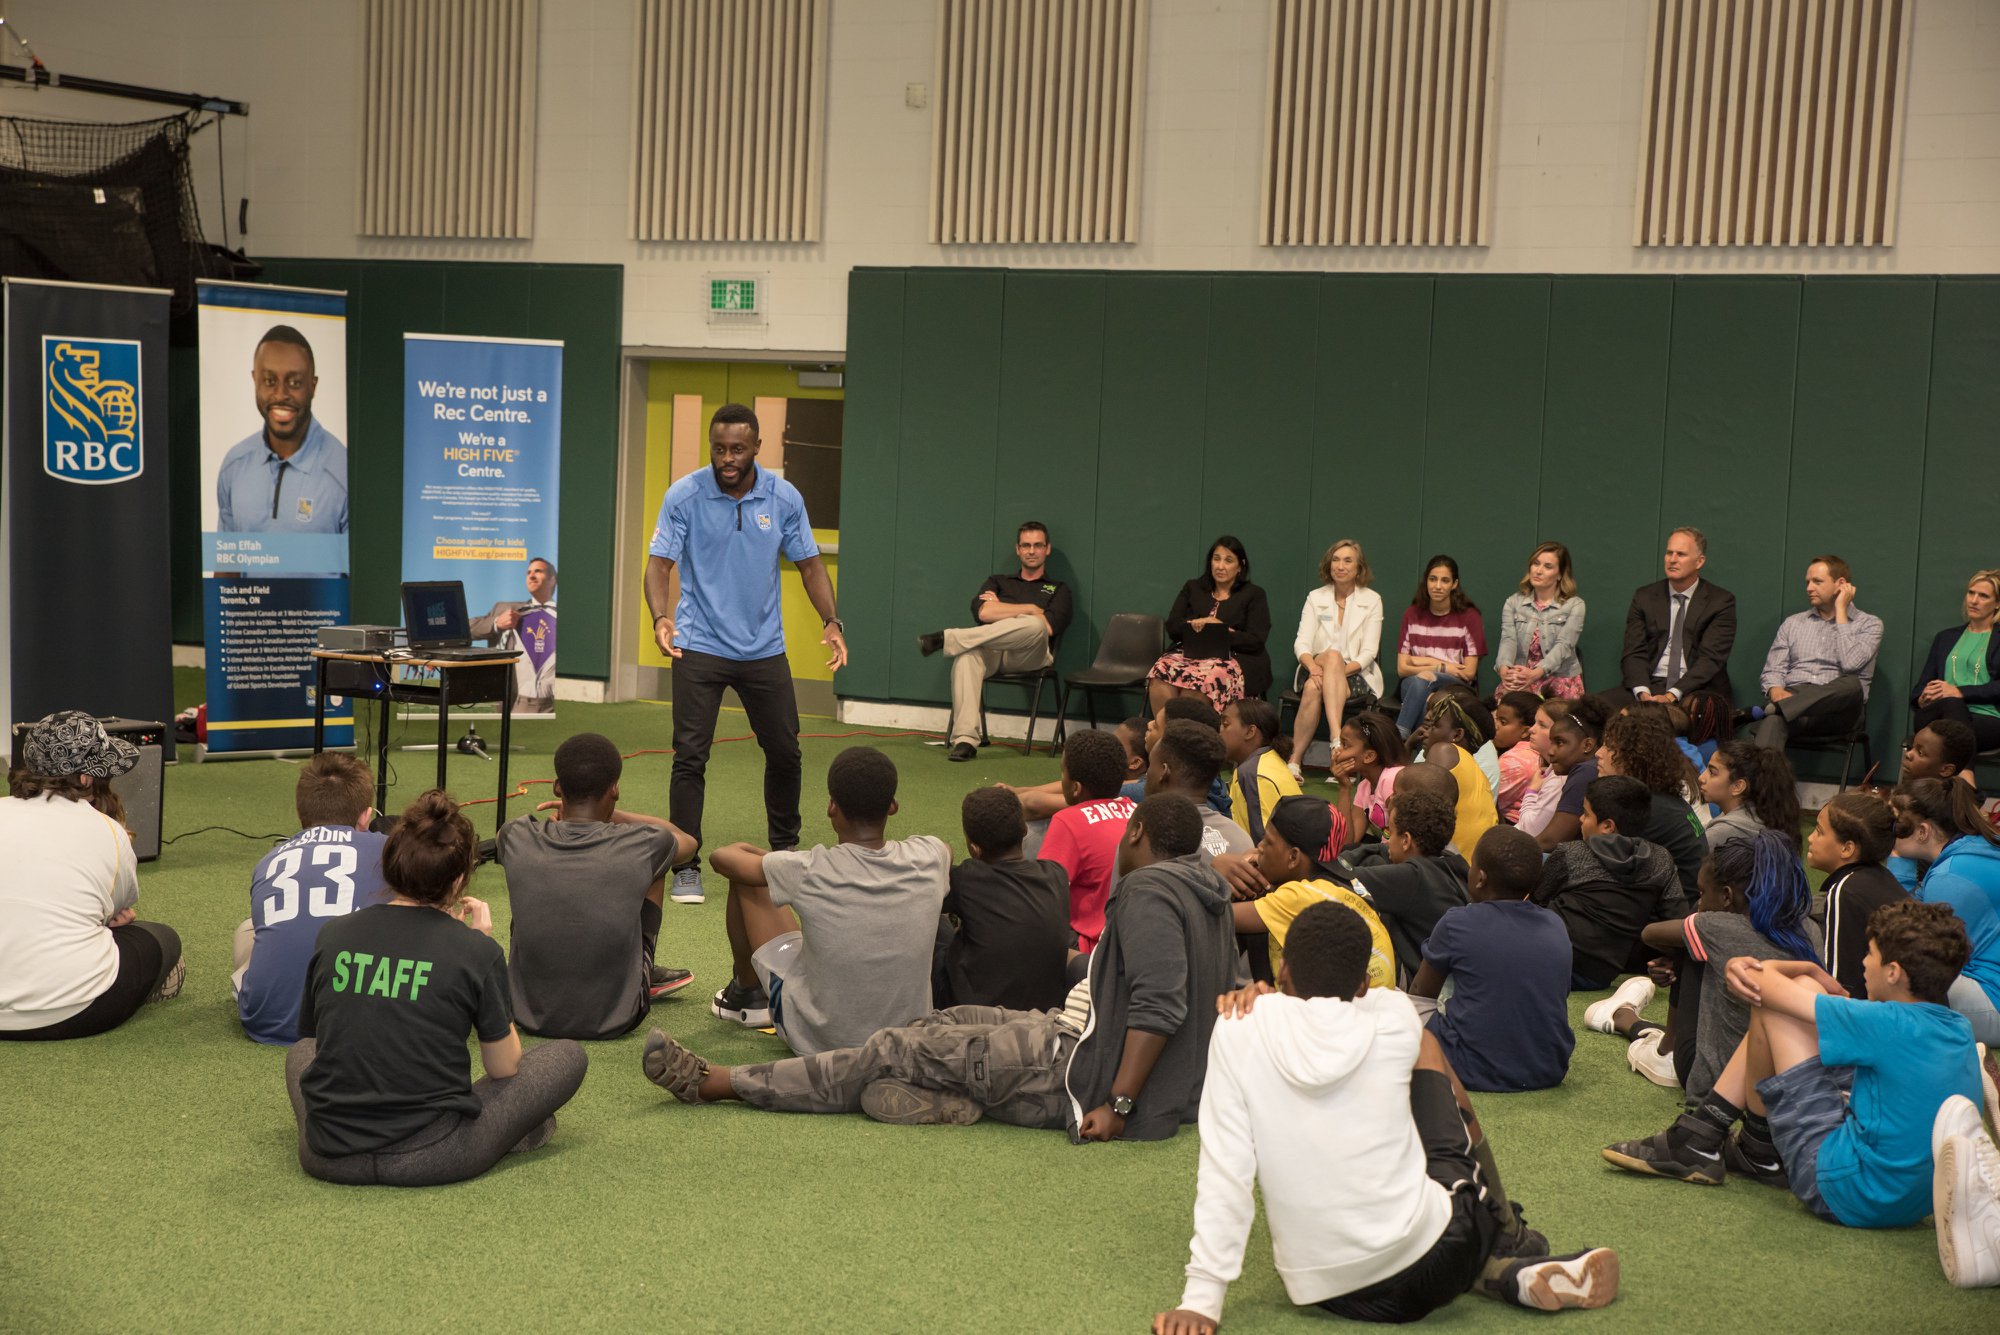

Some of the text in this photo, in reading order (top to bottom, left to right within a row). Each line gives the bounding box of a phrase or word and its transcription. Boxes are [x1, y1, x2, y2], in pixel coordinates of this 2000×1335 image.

[418, 380, 547, 404] We're not just a
[434, 403, 531, 423] Rec Centre.
[459, 431, 506, 446] We're a
[55, 441, 133, 472] RBC
[444, 447, 480, 461] HIGH
[458, 464, 505, 478] Centre.
[216, 540, 262, 551] Sam Effah
[436, 536, 525, 548] Choose quality for kids!
[216, 553, 280, 566] RBC Olympian
[220, 585, 270, 595] Track and Field
[220, 596, 260, 605] Toronto, ON
[296, 826, 352, 846] SEDIN
[264, 844, 358, 926] 33
[333, 951, 433, 1000] STAFF
